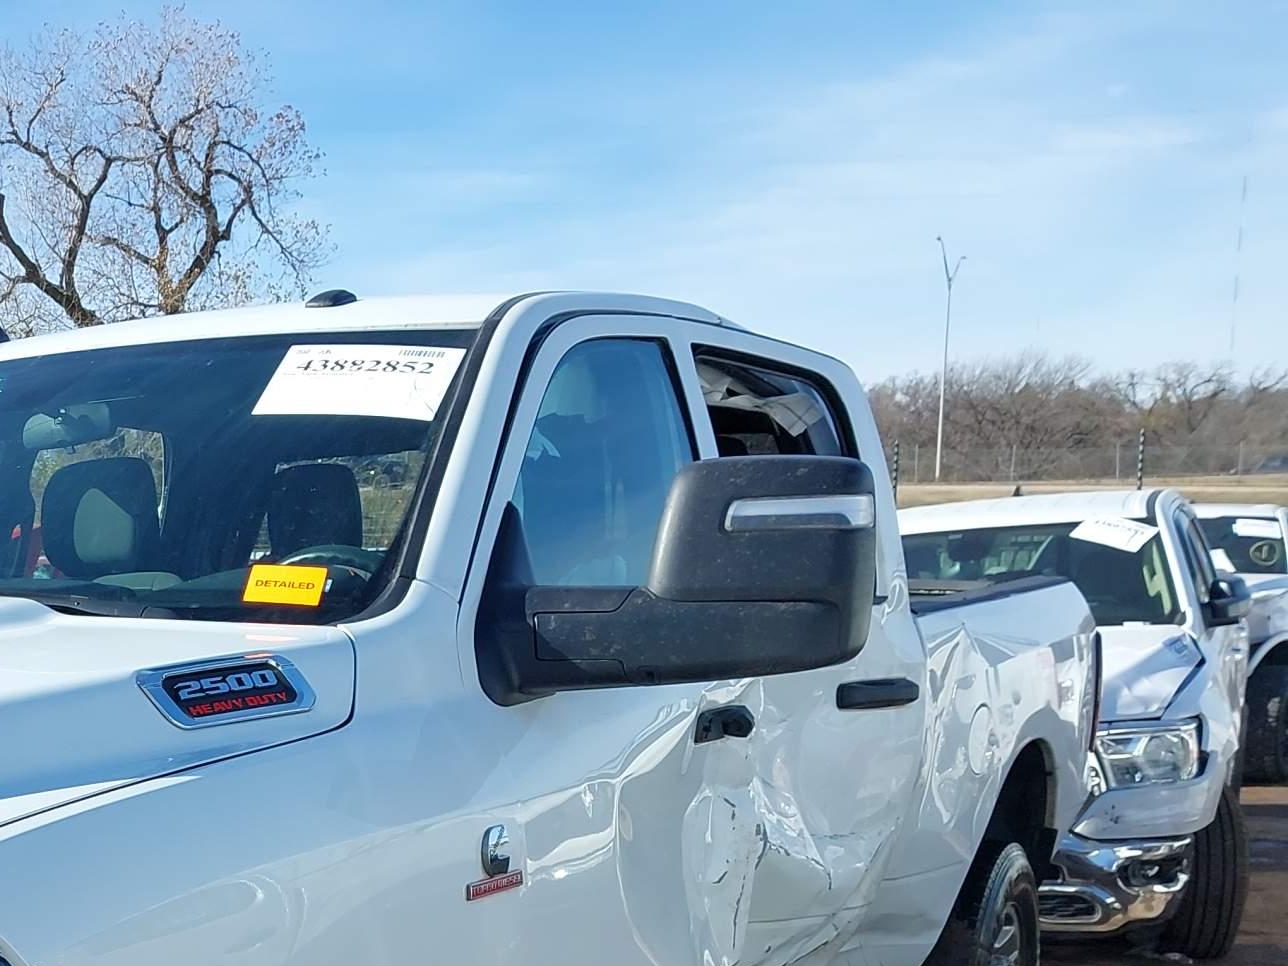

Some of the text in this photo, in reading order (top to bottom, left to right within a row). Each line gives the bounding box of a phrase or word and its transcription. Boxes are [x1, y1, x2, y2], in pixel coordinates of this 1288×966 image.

[296, 359, 434, 374] 43882852
[255, 580, 315, 590] DETAILED
[174, 670, 278, 700] 2500
[189, 692, 288, 716] HEAVY DUTY
